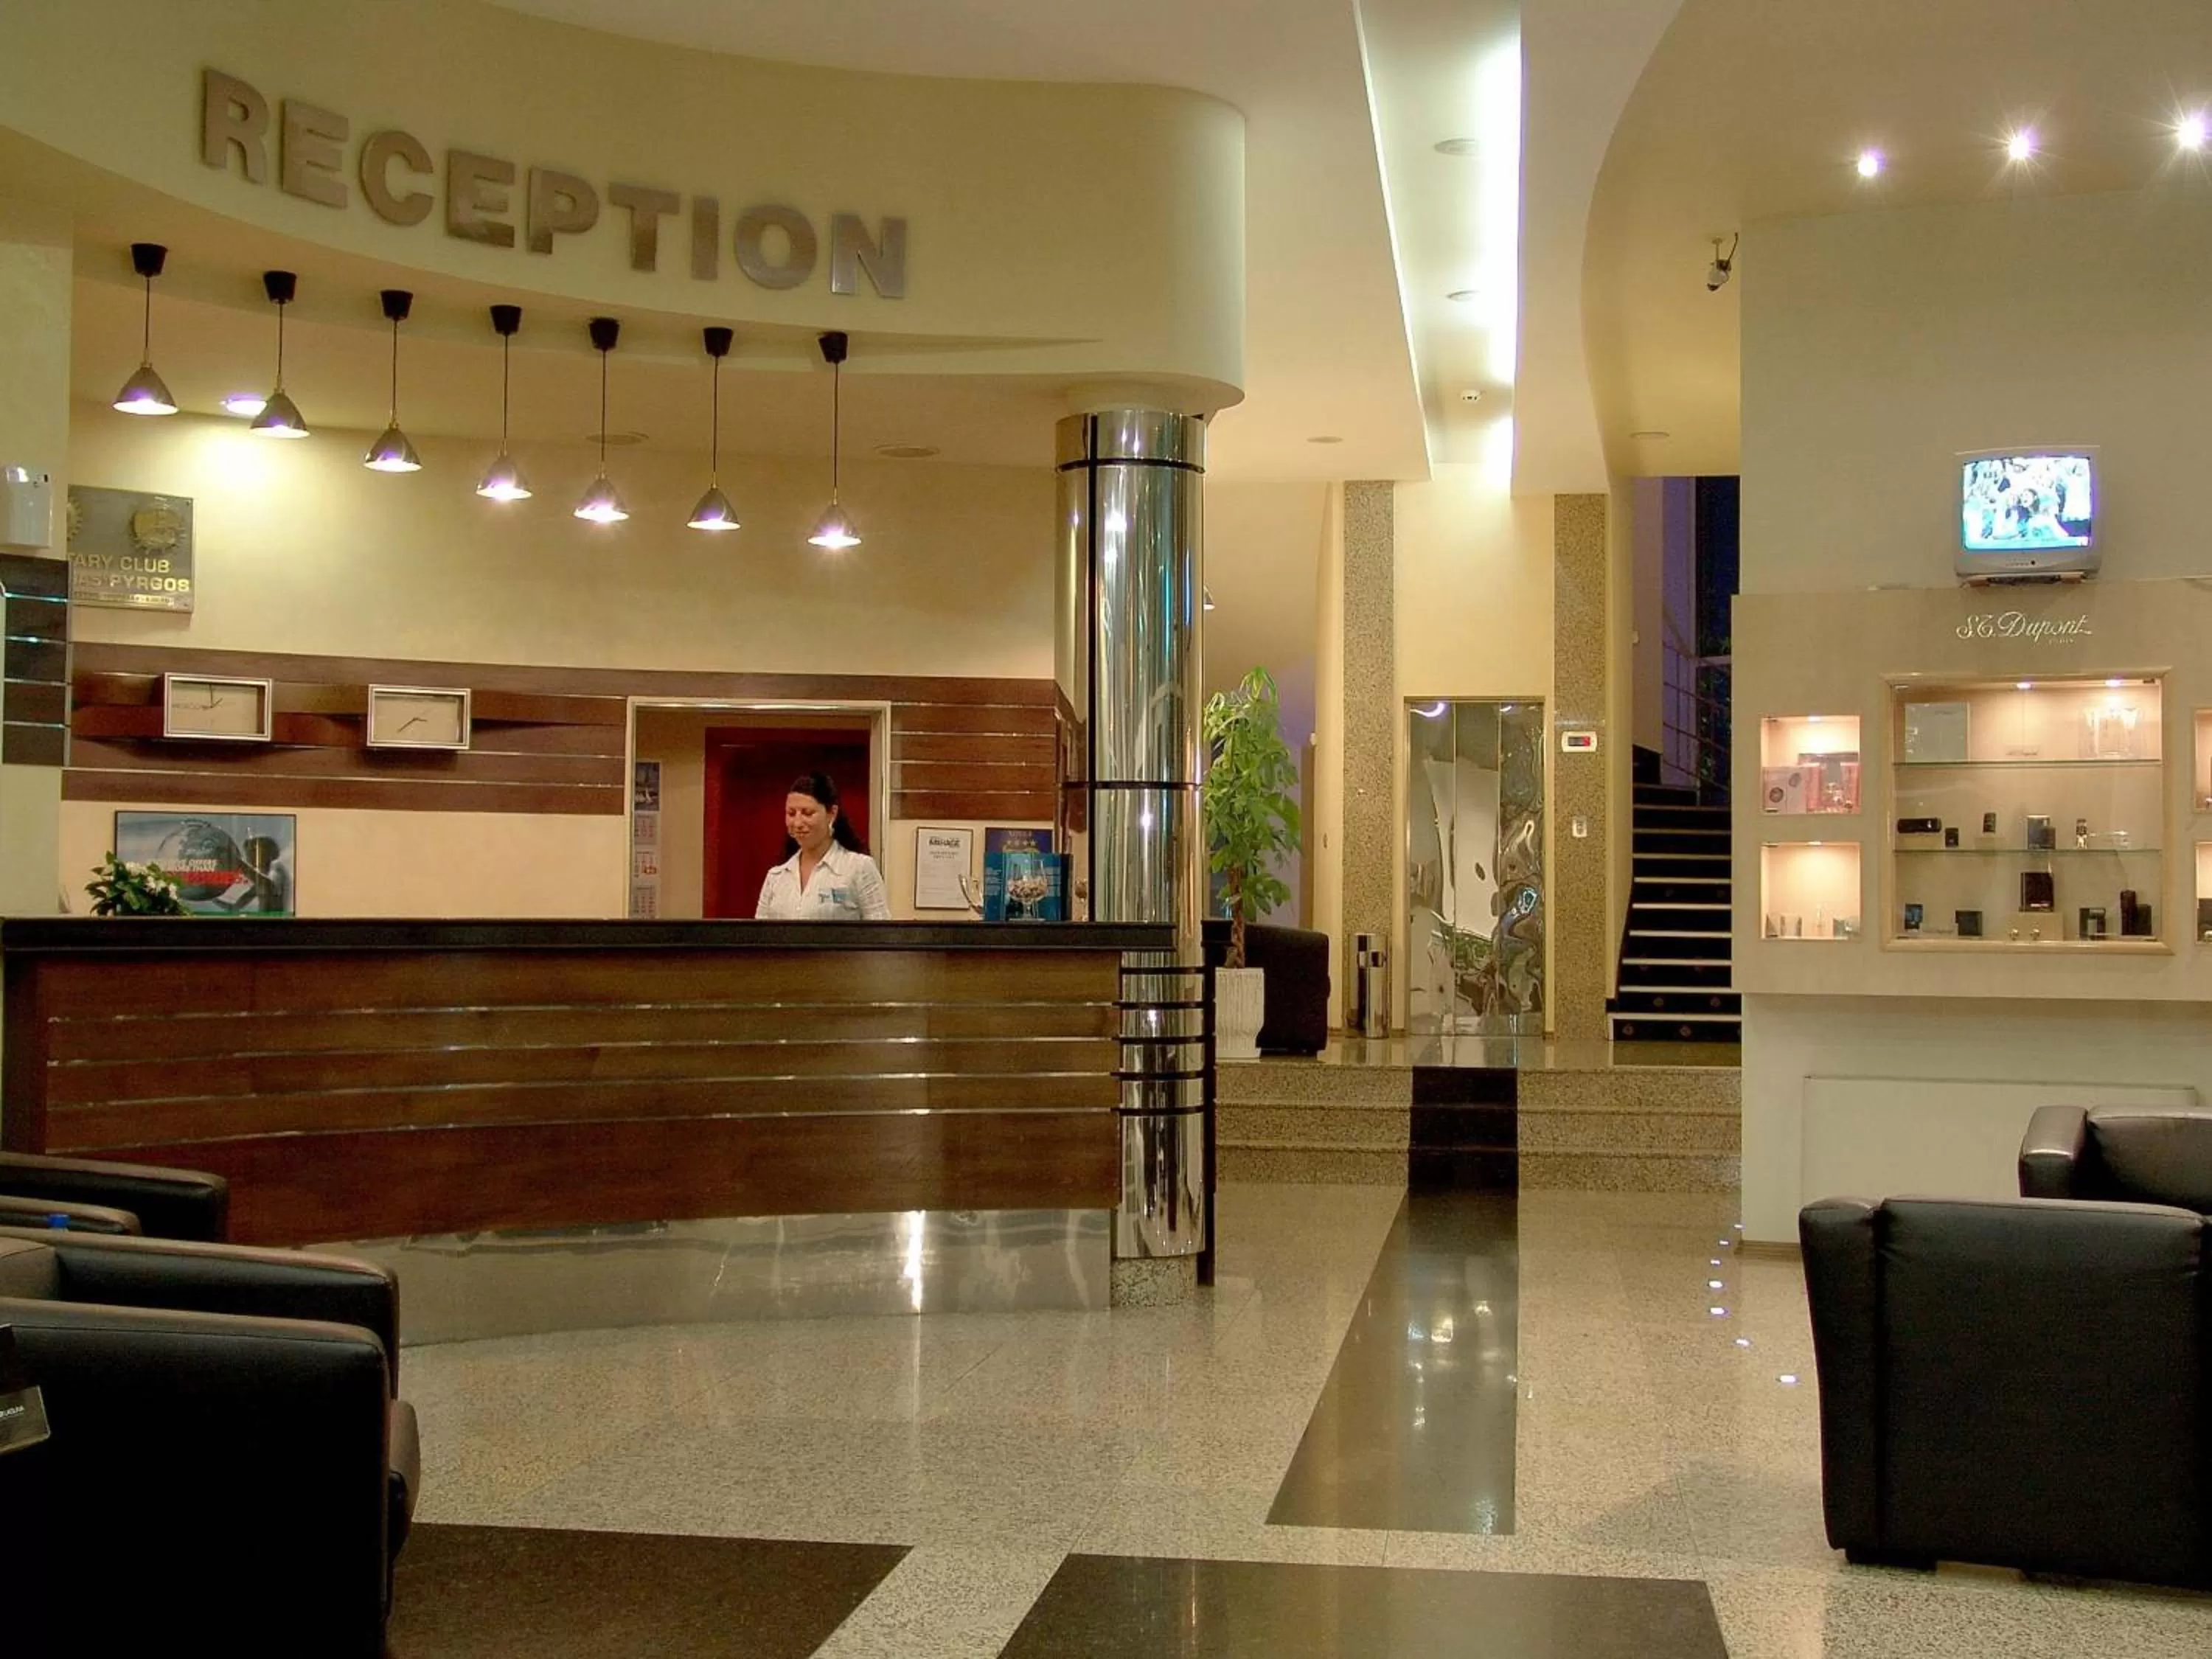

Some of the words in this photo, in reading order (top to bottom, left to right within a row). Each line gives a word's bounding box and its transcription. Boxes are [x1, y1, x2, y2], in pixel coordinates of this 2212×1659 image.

[201, 67, 907, 299] RECEPTION
[119, 556, 171, 574] CLUB
[110, 574, 189, 592] PYRGOS
